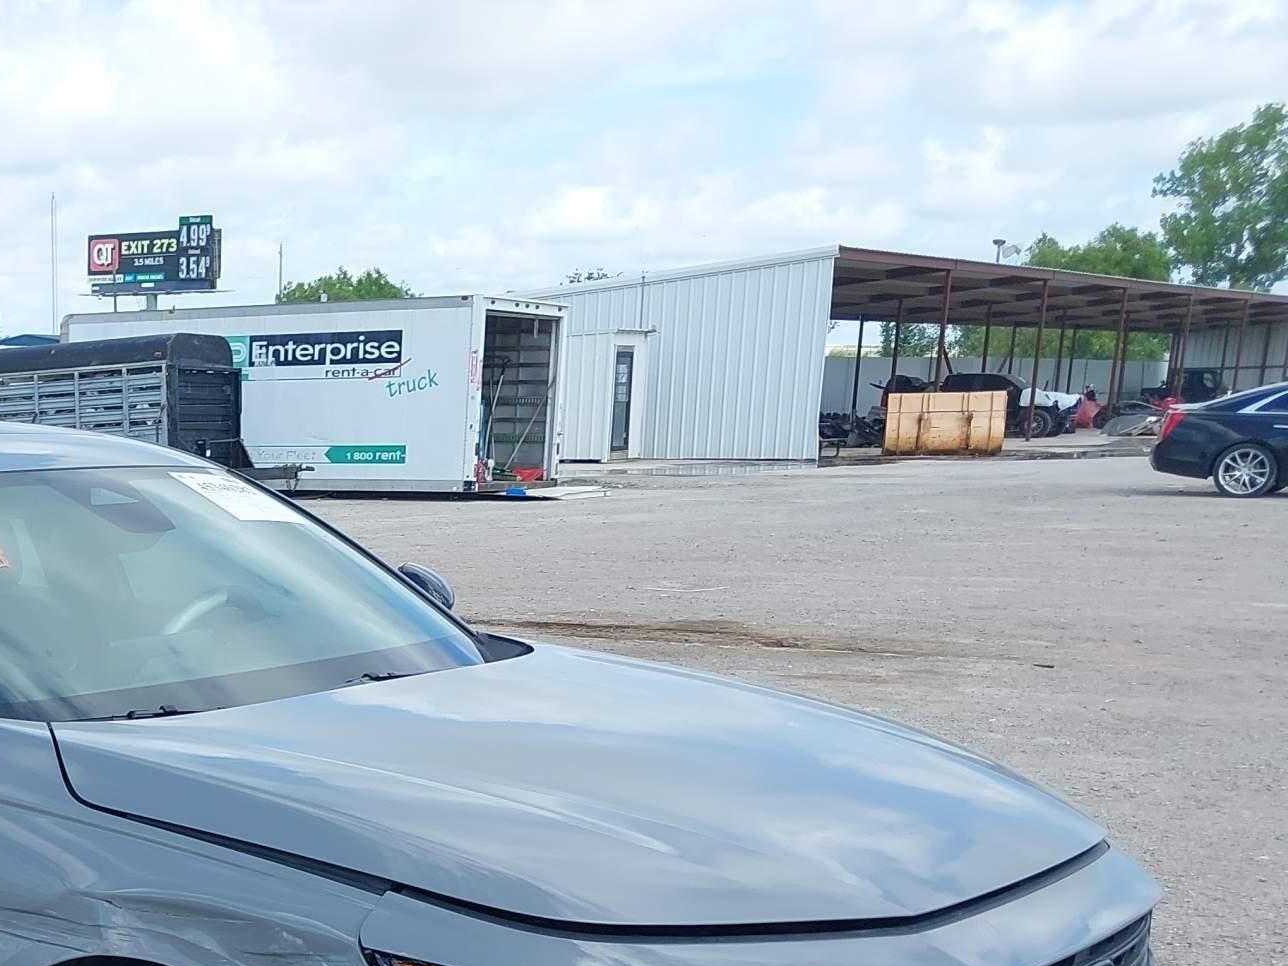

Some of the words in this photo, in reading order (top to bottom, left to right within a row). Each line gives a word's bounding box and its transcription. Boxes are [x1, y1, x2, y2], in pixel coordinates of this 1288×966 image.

[93, 243, 115, 267] QT
[121, 240, 150, 255] EXIT
[153, 238, 177, 253] 273
[251, 335, 400, 366] Enterprise
[386, 369, 439, 398] truck
[345, 452, 352, 461] 1
[353, 452, 374, 461] 800
